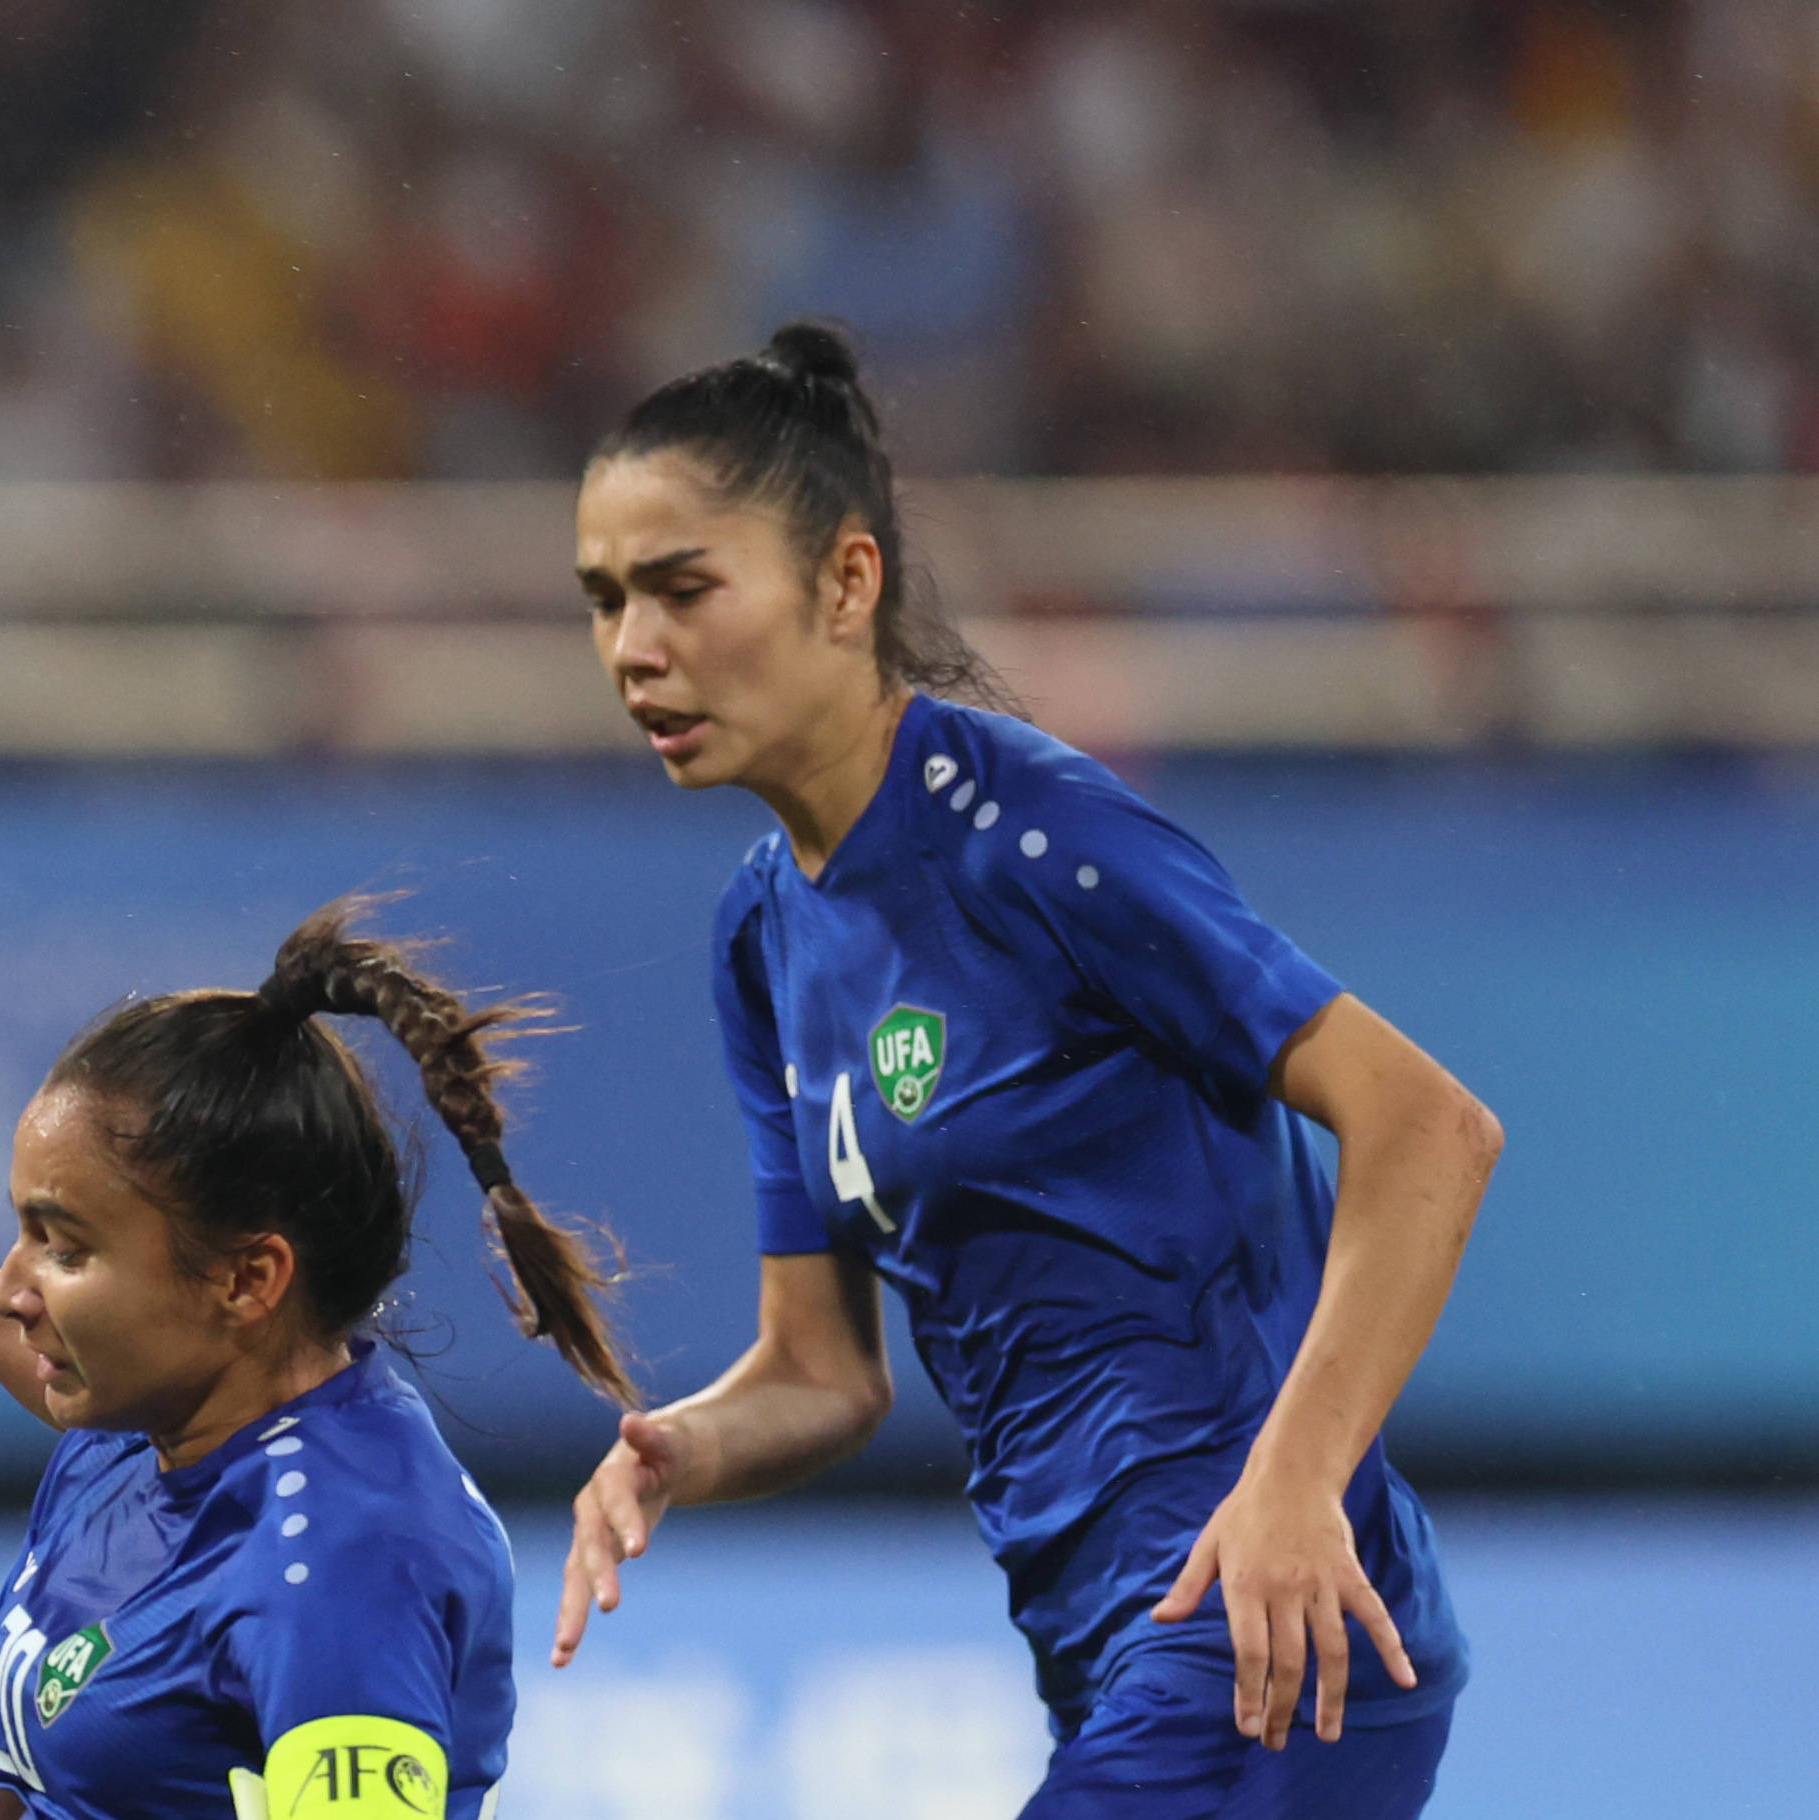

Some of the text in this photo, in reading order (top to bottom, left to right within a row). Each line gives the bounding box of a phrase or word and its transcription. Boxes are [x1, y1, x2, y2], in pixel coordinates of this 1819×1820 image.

[876, 1025, 936, 1077] UFA
[828, 1070, 897, 1235] 4
[46, 1632, 96, 1684] UFA
[289, 1744, 438, 1816] AFC
